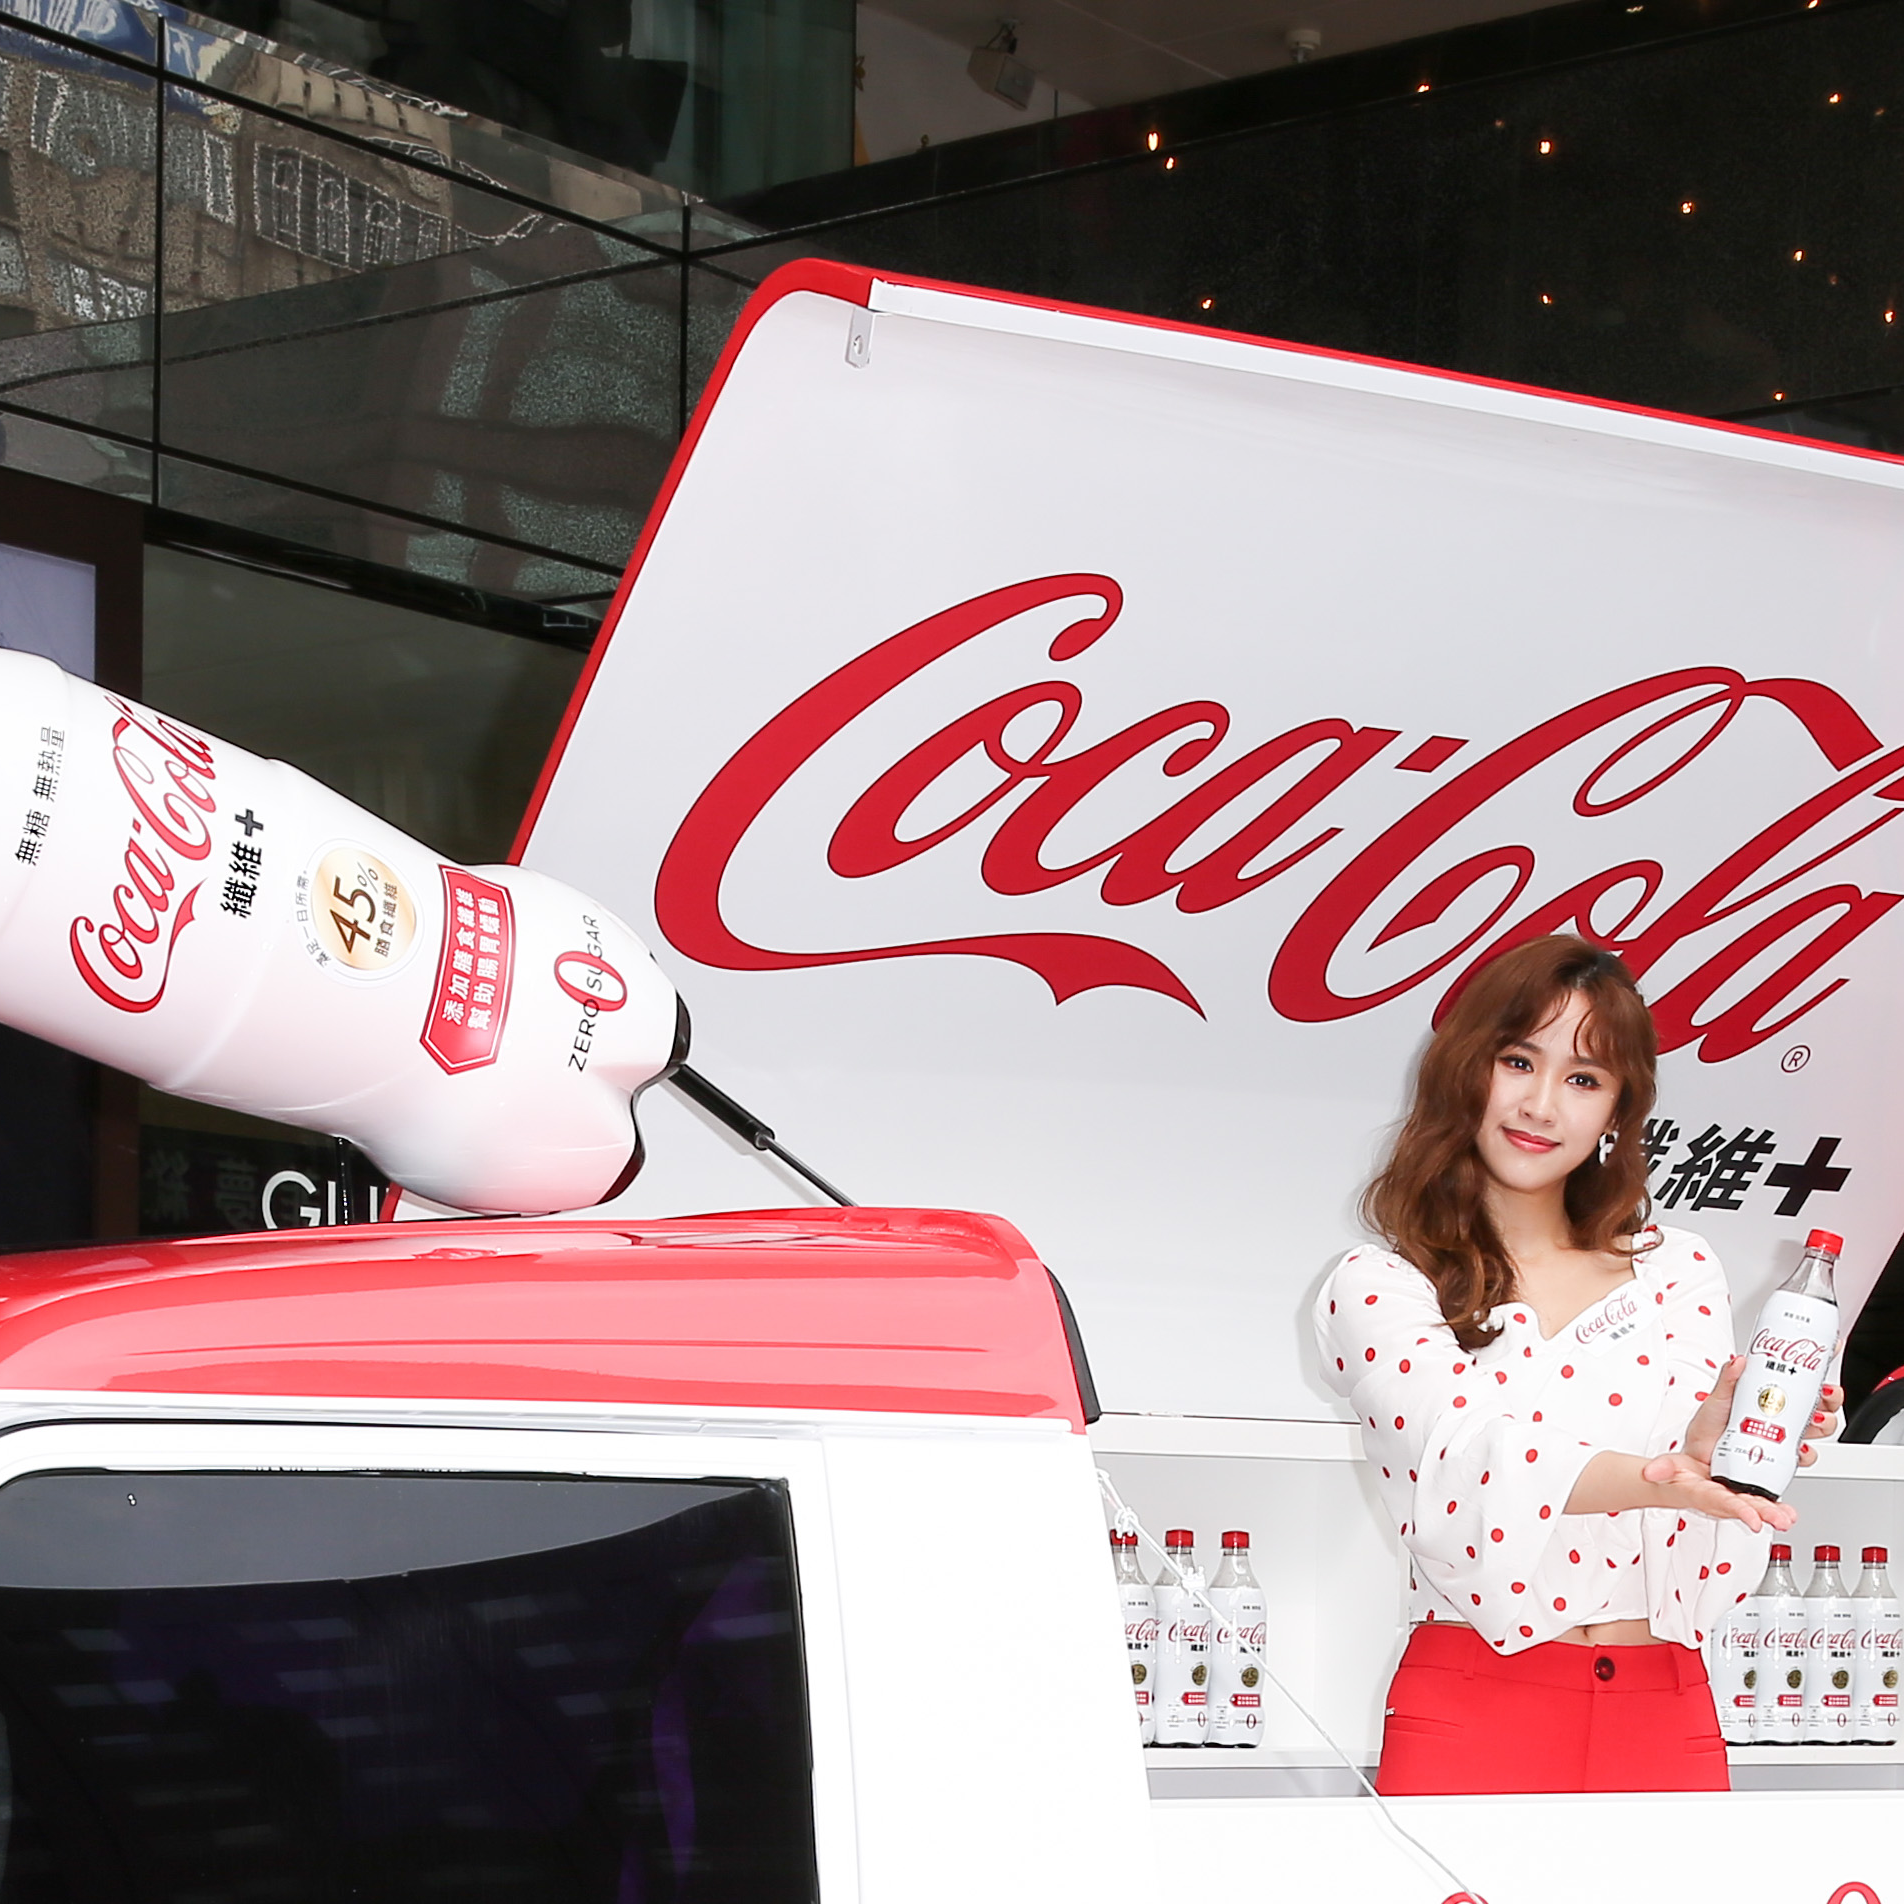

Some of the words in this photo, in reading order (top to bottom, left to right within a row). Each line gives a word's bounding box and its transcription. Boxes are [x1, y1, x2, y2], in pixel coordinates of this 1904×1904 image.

[14, 809, 51, 866] 無糖
[70, 691, 216, 1014] Coca-Cola
[329, 861, 380, 955] 45%
[442, 887, 476, 1026] 添加膳食纖維
[1575, 1291, 1638, 1345] Coca-Cola
[1750, 1328, 1828, 1370] Coca-Cola
